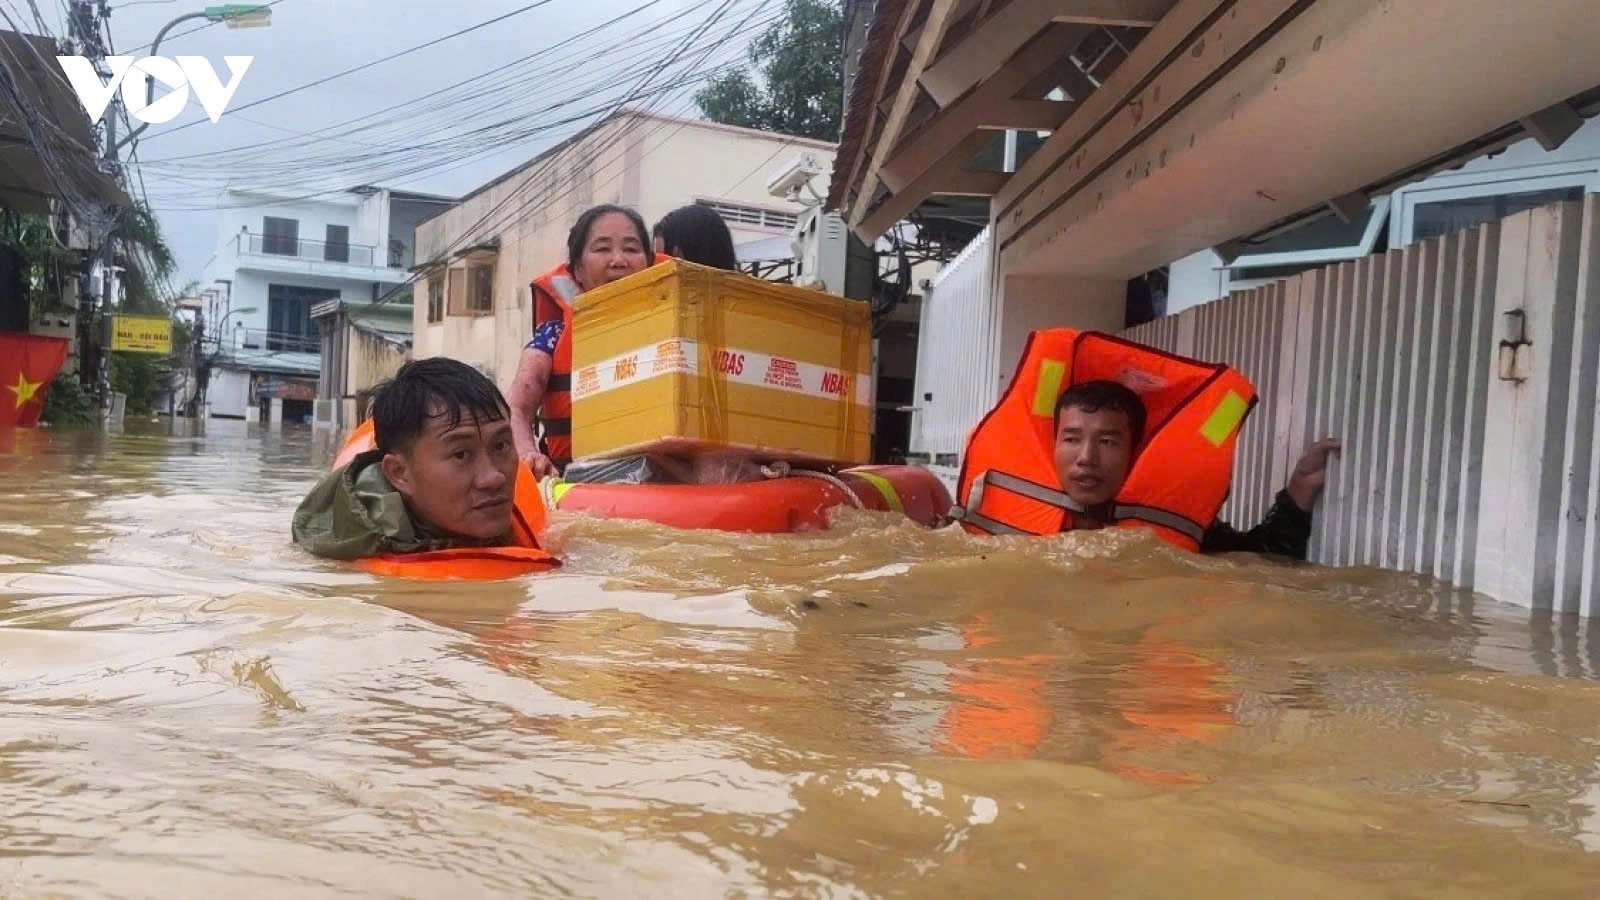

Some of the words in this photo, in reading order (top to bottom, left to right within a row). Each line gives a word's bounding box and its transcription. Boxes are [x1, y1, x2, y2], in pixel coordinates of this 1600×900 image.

[614, 355, 638, 381] NBAS
[711, 349, 745, 376] NBAS
[820, 371, 851, 396] NBAS
